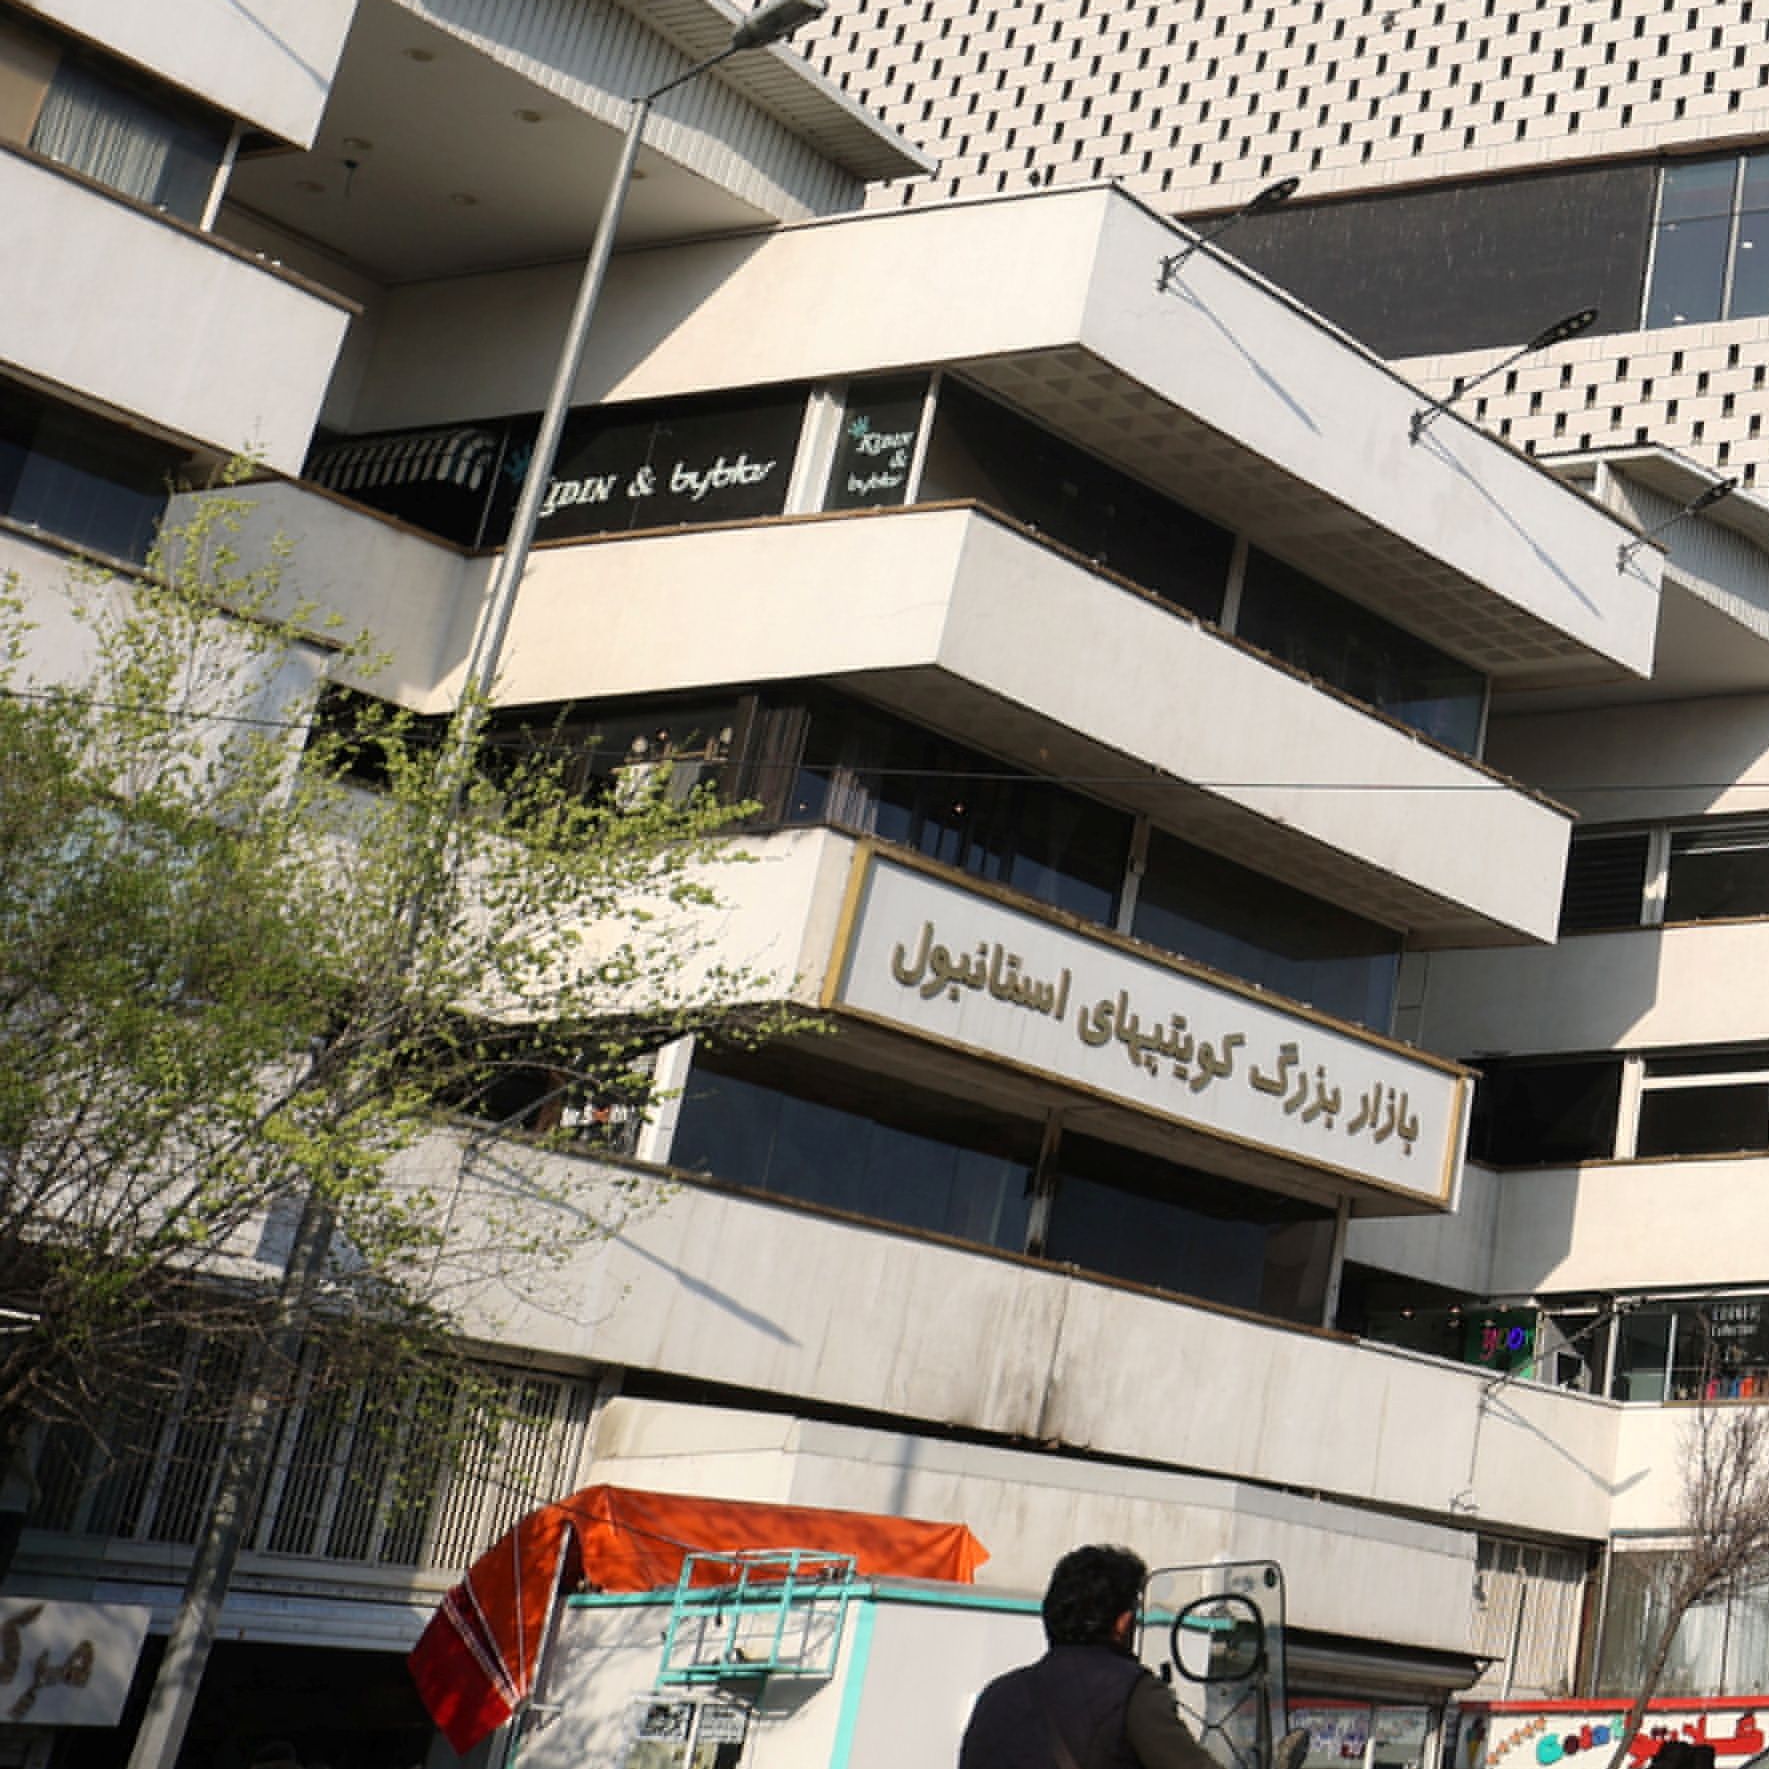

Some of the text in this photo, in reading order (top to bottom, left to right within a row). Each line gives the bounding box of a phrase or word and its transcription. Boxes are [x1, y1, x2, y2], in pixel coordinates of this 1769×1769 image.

[626, 462, 657, 498] &
[892, 921, 1072, 1021] استانبول
[1248, 1041, 1343, 1129] بزرگ
[1347, 1079, 1422, 1154] بازار
